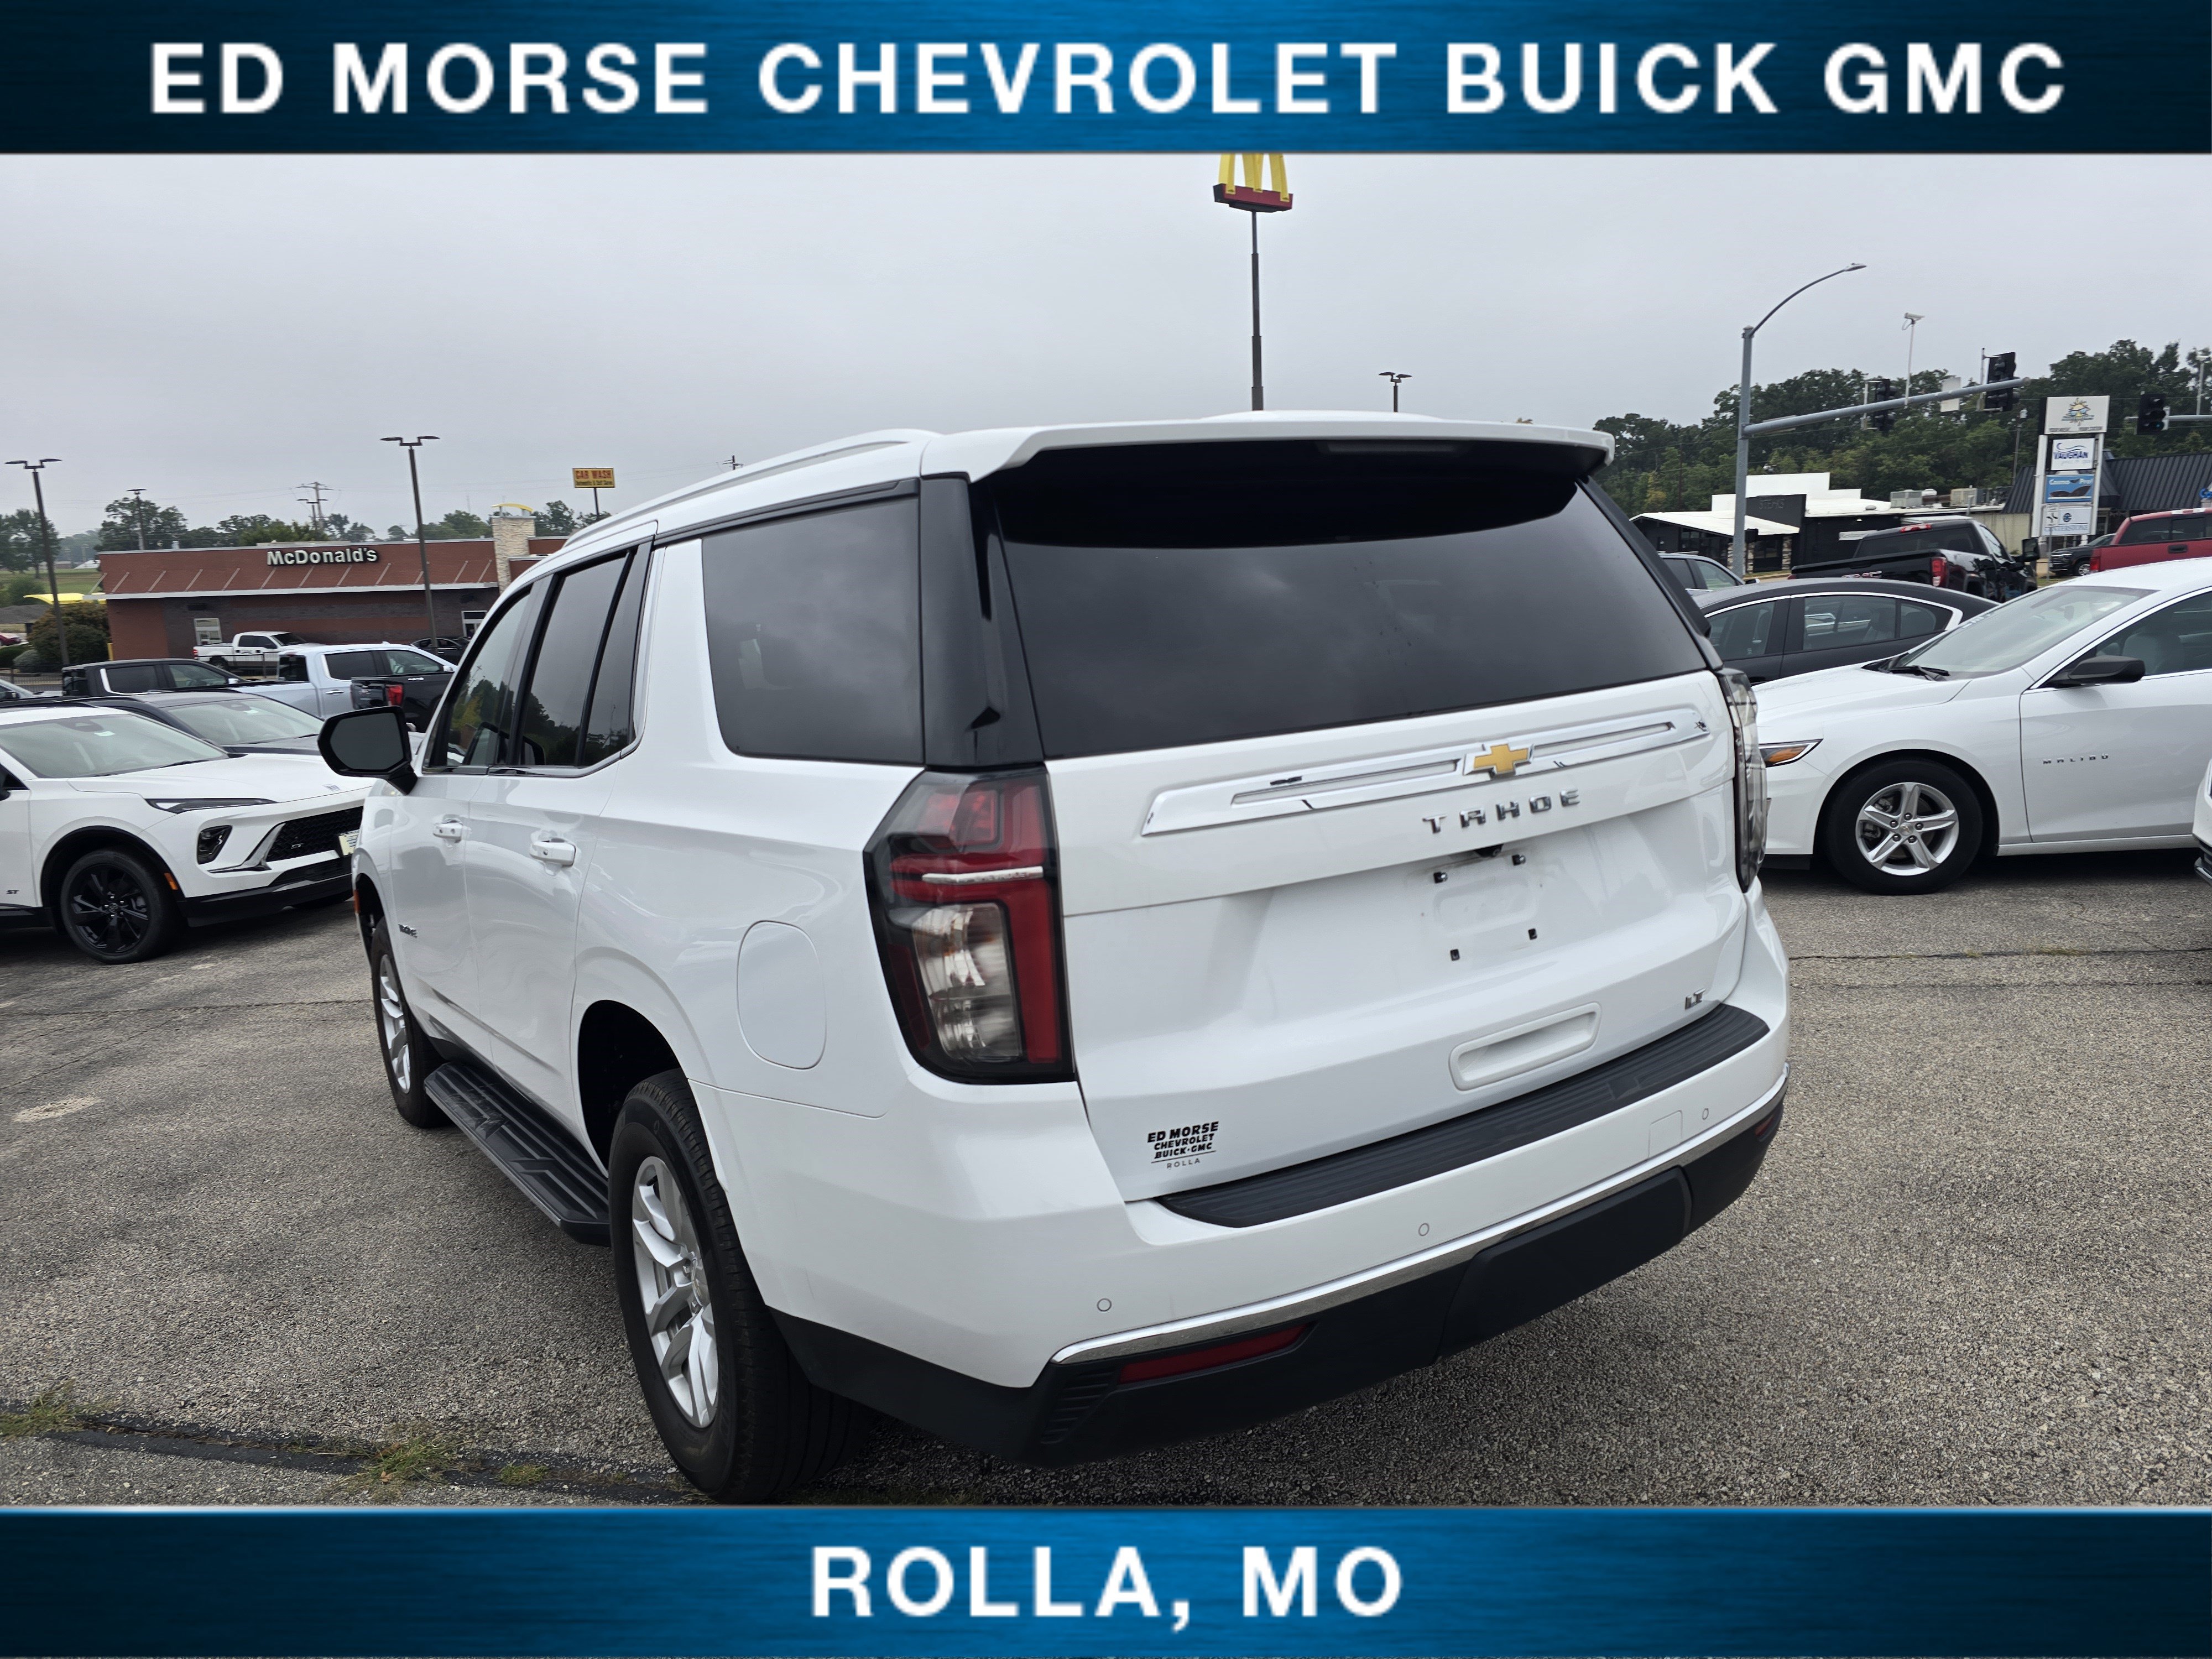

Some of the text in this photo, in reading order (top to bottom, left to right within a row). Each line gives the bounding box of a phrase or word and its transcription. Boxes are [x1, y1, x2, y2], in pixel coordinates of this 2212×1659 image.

[267, 547, 378, 565] McDonald's
[2042, 754, 2109, 764] MALIBU
[1422, 787, 1580, 834] TAHOE
[1684, 988, 1706, 1010] LT
[1147, 1120, 1219, 1143] ED MORSE
[1154, 1133, 1215, 1150] CHEVROLET
[1166, 1157, 1201, 1169] ROLLA
